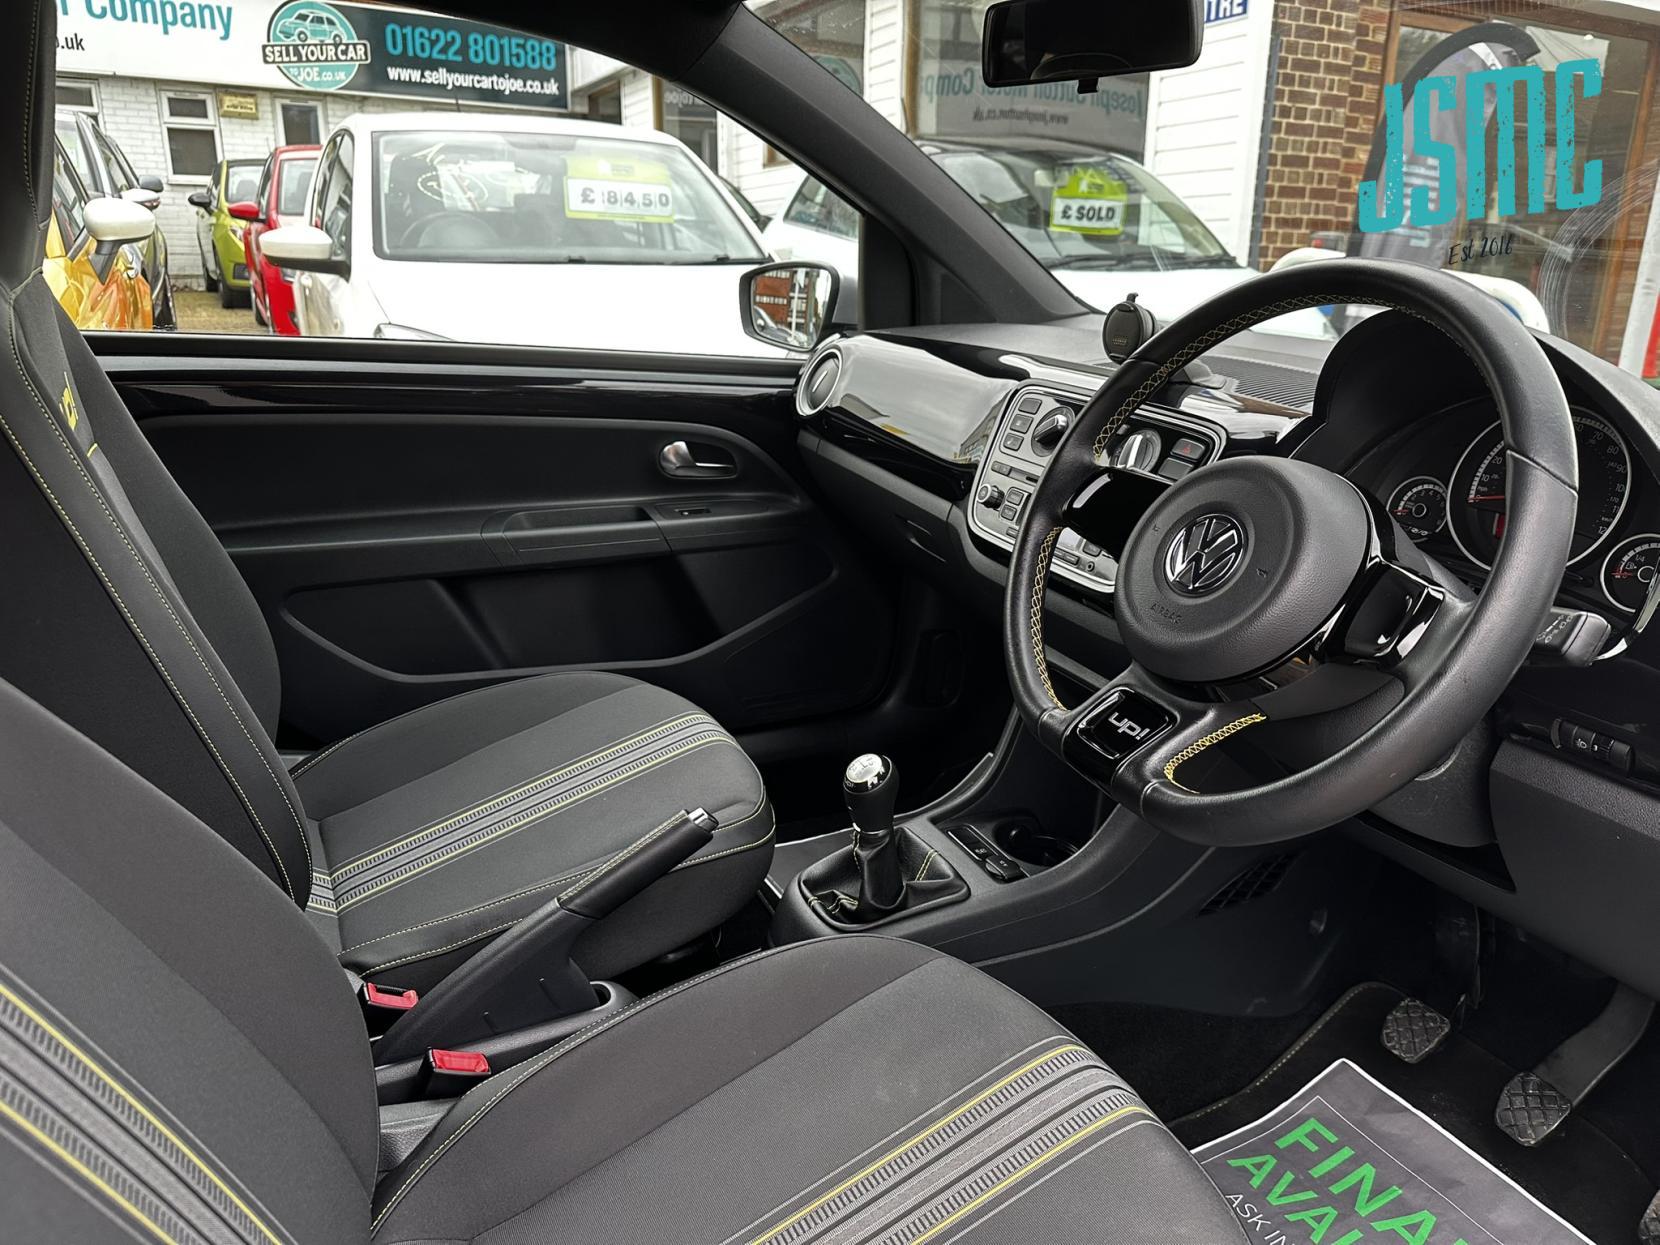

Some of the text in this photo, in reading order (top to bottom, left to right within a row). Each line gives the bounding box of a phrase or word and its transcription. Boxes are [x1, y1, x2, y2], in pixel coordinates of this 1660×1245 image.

[85, 0, 232, 40] Company
[265, 44, 368, 62] SELL YOUR CAR
[385, 22, 557, 71] 01622 801588
[386, 66, 560, 96] www.sellyourcartojoe.co.uk
[580, 187, 595, 204] £
[1061, 204, 1115, 222] £ SOLD
[1108, 711, 1151, 741] up!
[1274, 1117, 1469, 1245] FINA
[1225, 1194, 1272, 1231] ASK
